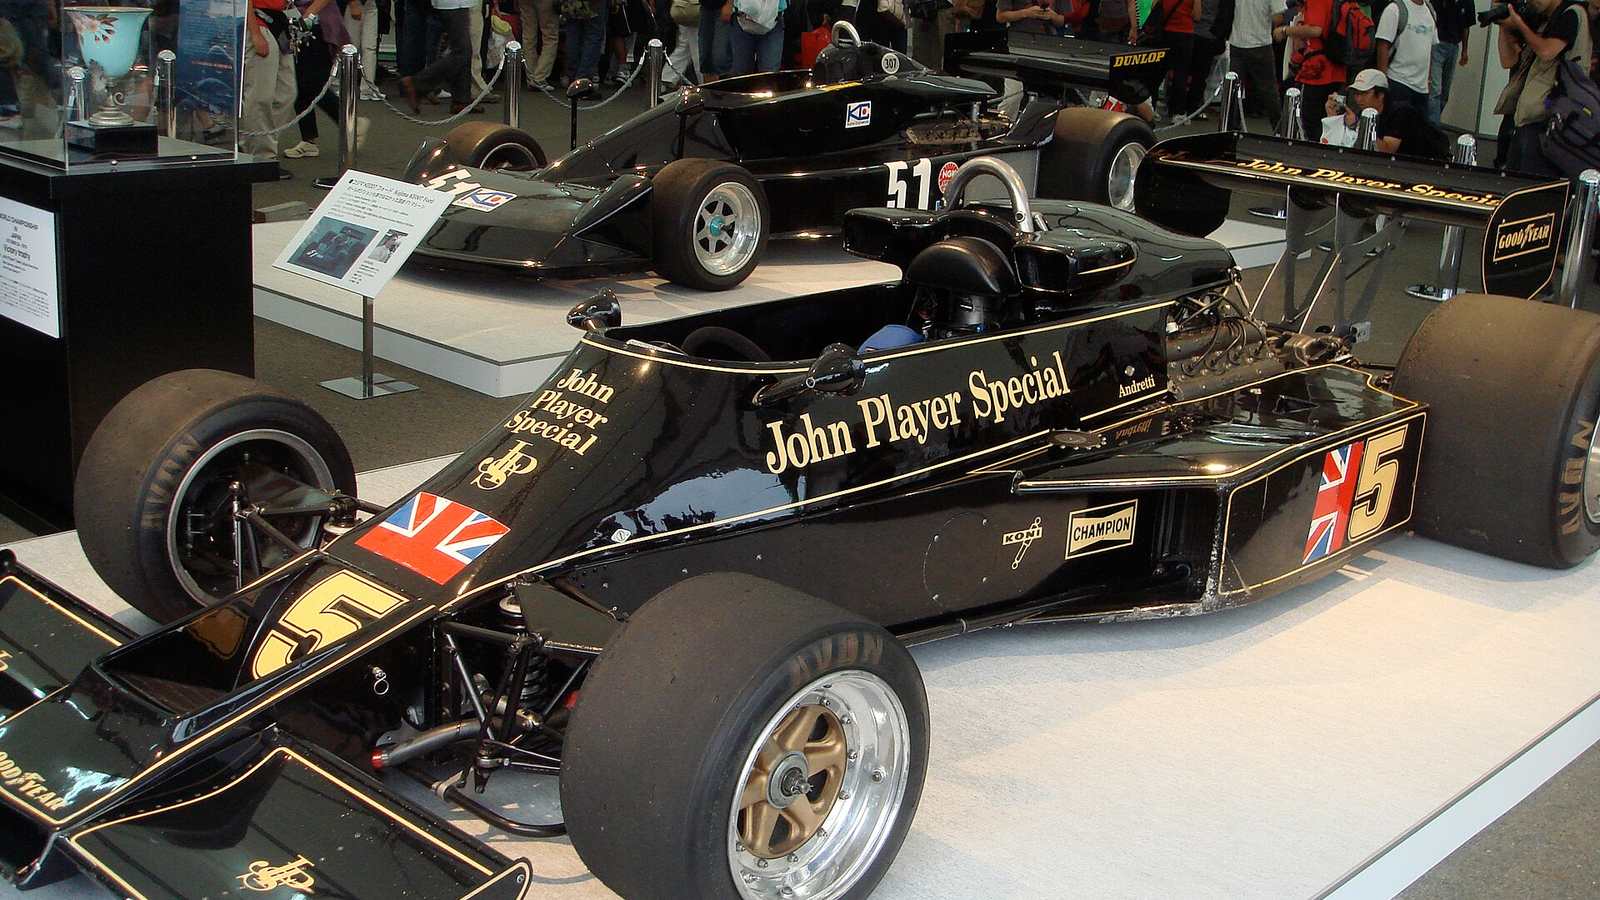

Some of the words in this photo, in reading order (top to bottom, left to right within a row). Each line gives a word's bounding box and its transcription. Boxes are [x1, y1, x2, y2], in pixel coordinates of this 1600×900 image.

[1113, 51, 1166, 67] DUNLOP
[884, 157, 931, 210] 51
[1236, 158, 1303, 176] John
[1499, 223, 1550, 250] GOODYEAR
[557, 368, 615, 404] John
[1119, 374, 1156, 398] Andretti
[530, 390, 608, 430] Player
[766, 413, 856, 474] John
[857, 391, 961, 449] Player
[968, 351, 1071, 424] Special
[504, 410, 598, 456] Special
[1347, 423, 1409, 542] 5
[1005, 529, 1040, 543] KONI
[1073, 516, 1131, 541] CHAMPION
[253, 569, 410, 680] 5
